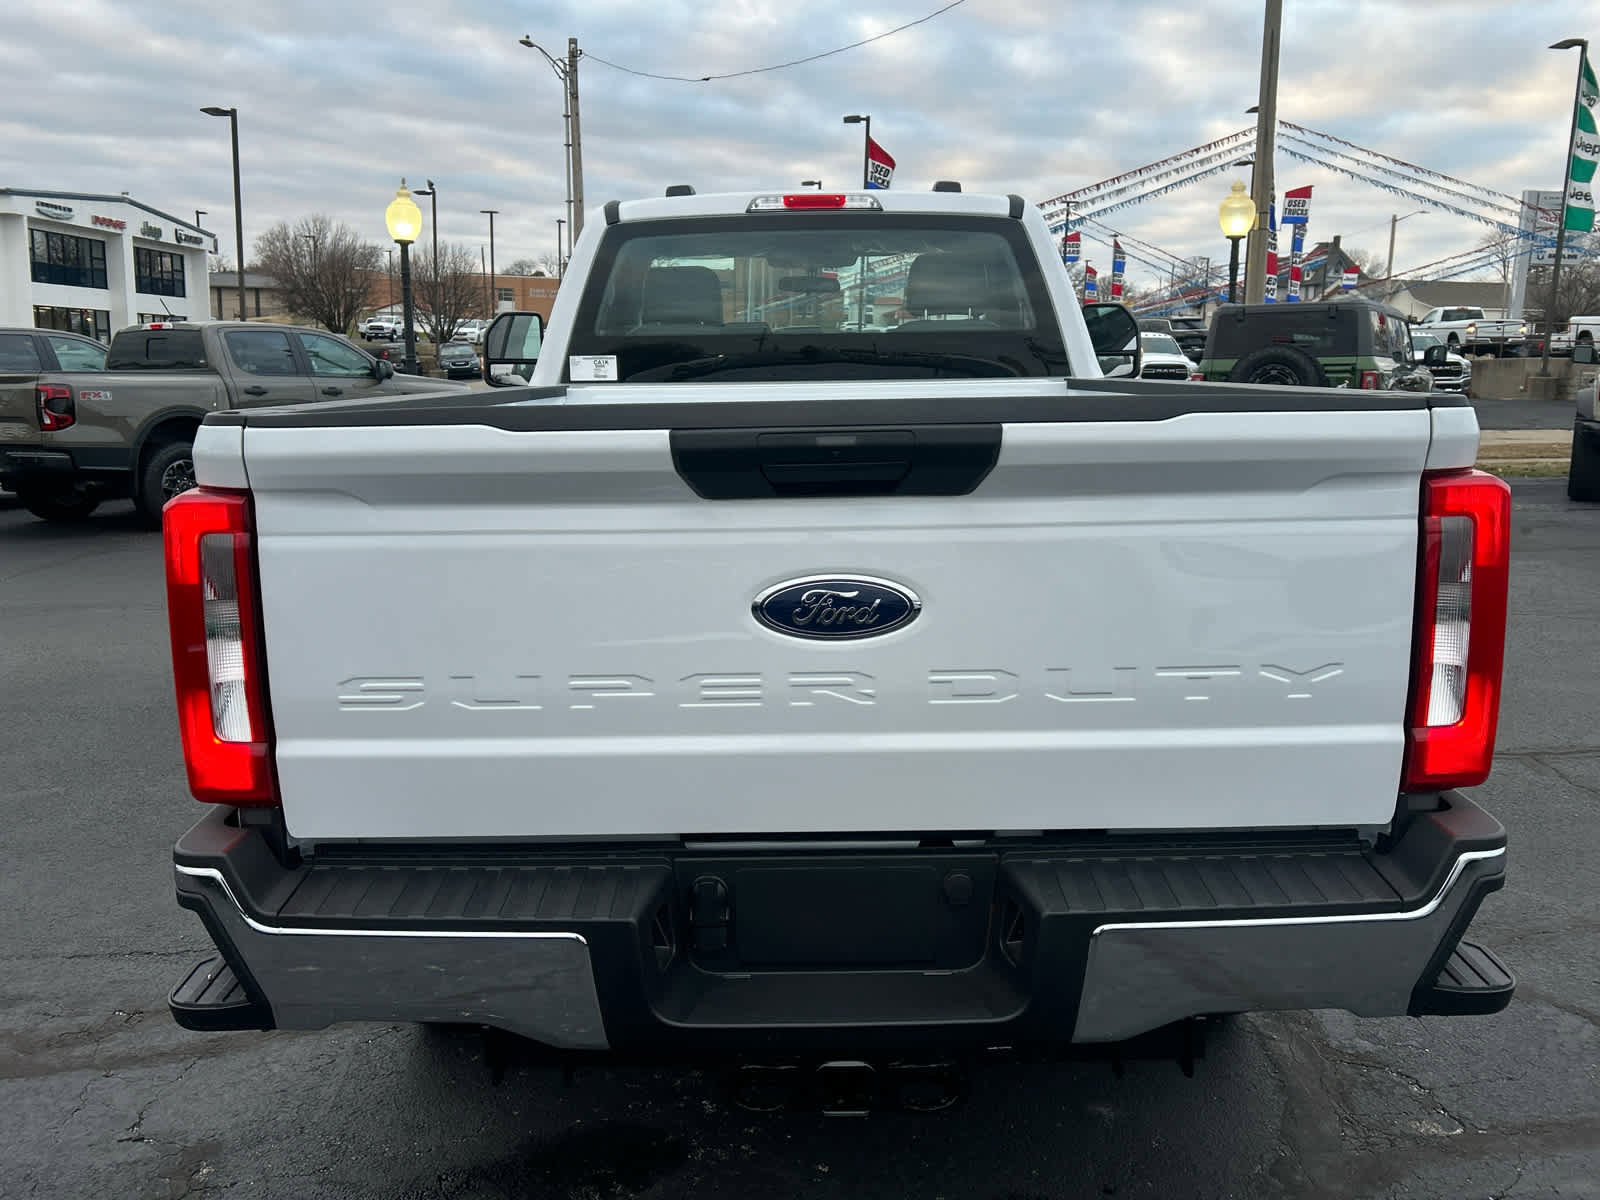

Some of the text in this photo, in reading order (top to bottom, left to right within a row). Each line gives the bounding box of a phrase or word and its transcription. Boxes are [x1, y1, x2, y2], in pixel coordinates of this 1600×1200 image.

[1287, 199, 1306, 208] USED
[792, 589, 882, 625] Ford
[337, 662, 1345, 711] SUPER DUTY
